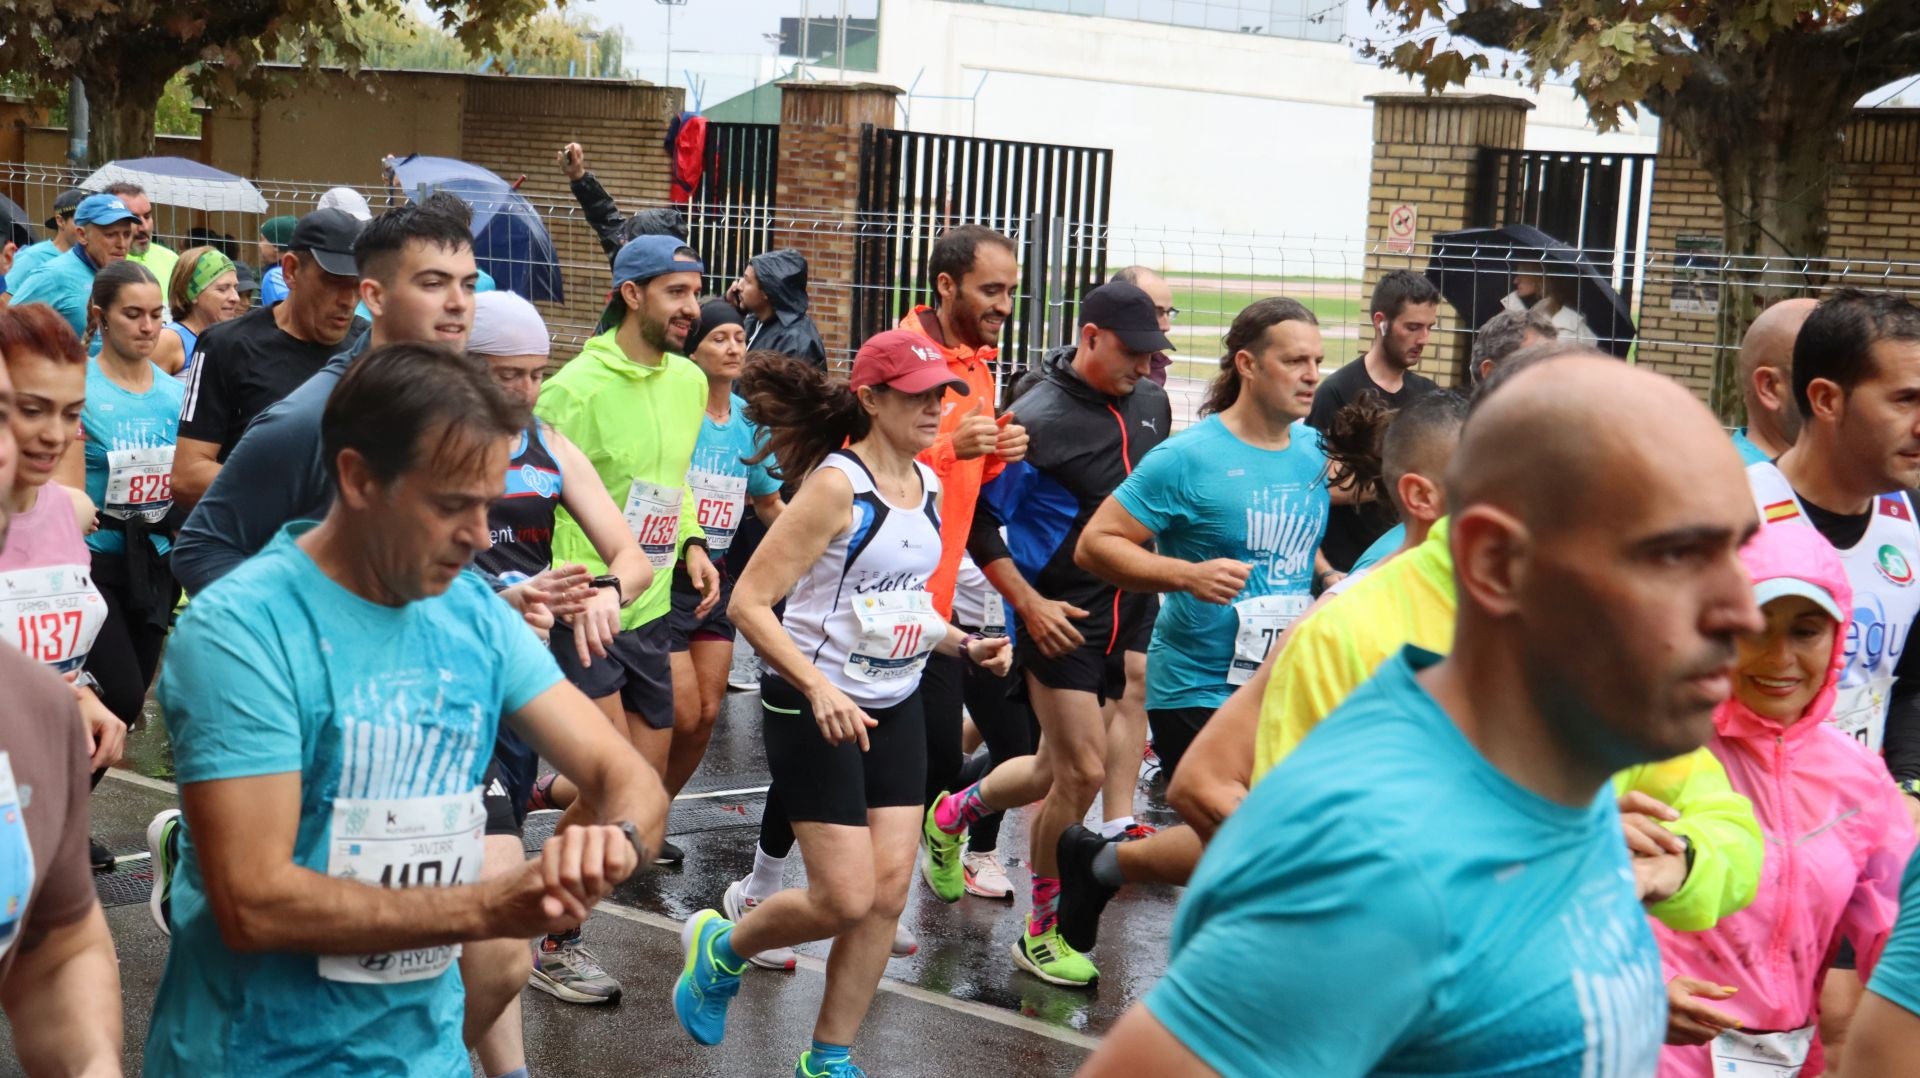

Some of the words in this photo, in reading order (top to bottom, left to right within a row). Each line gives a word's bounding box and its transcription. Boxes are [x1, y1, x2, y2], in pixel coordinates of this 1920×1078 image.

[129, 473, 172, 504] 828
[698, 498, 734, 529] 675
[638, 514, 679, 545] 1139
[18, 610, 83, 662] 1137
[890, 624, 922, 658] 711
